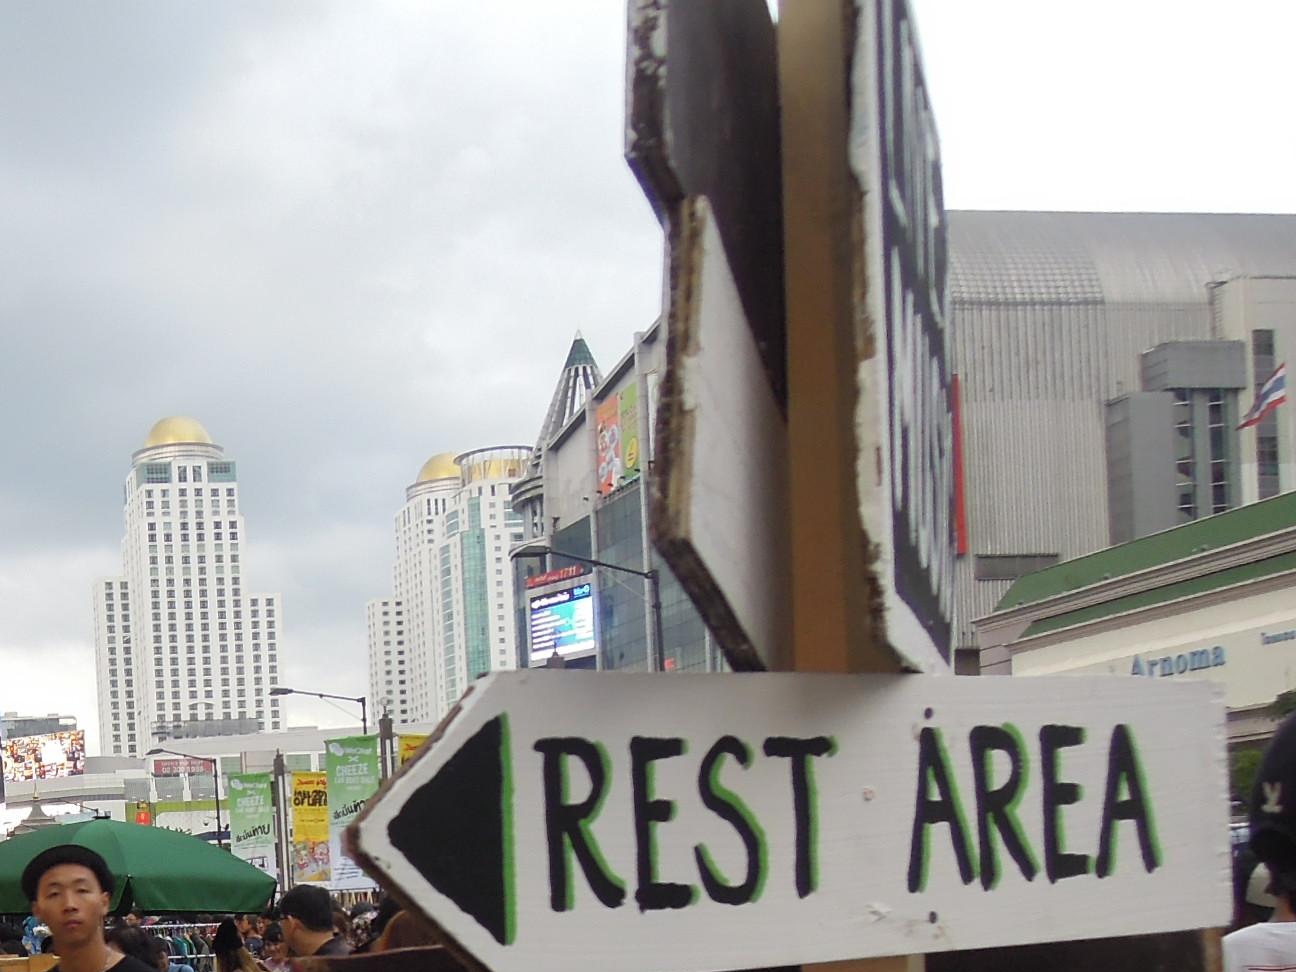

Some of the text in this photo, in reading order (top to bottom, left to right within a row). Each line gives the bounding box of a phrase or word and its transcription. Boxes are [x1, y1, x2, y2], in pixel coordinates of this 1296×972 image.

[1132, 646, 1227, 678] Arnoma
[336, 763, 369, 776] CHEEZE
[533, 722, 1163, 914] REST AREA
